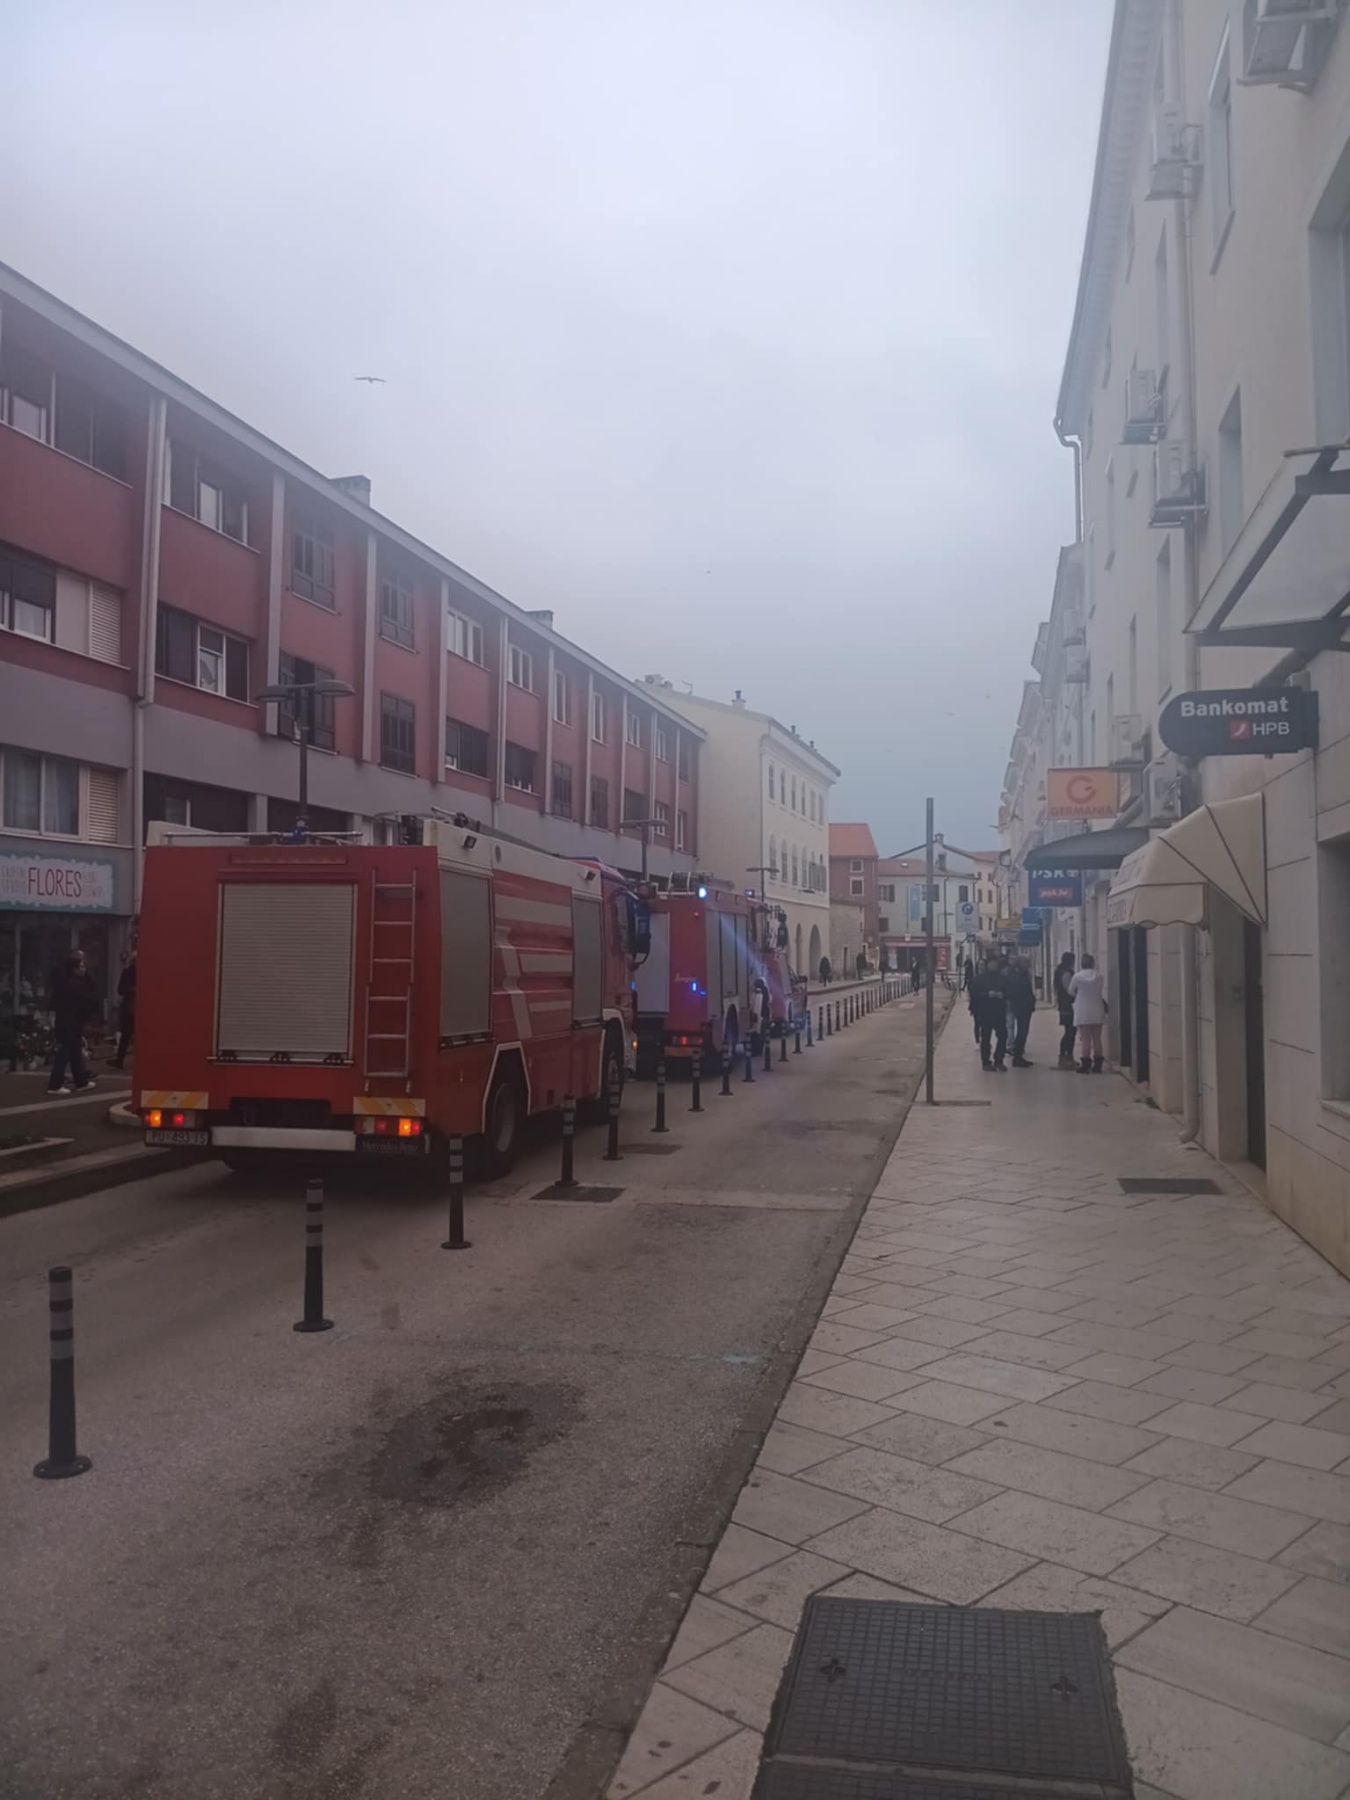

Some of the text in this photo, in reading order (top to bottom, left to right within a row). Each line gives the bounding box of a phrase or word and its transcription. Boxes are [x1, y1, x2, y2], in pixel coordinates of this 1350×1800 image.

[1180, 696, 1289, 717] Bankomat
[1252, 721, 1290, 736] HPB
[1050, 806, 1113, 817] GERMANIA
[28, 867, 82, 898] FLORES
